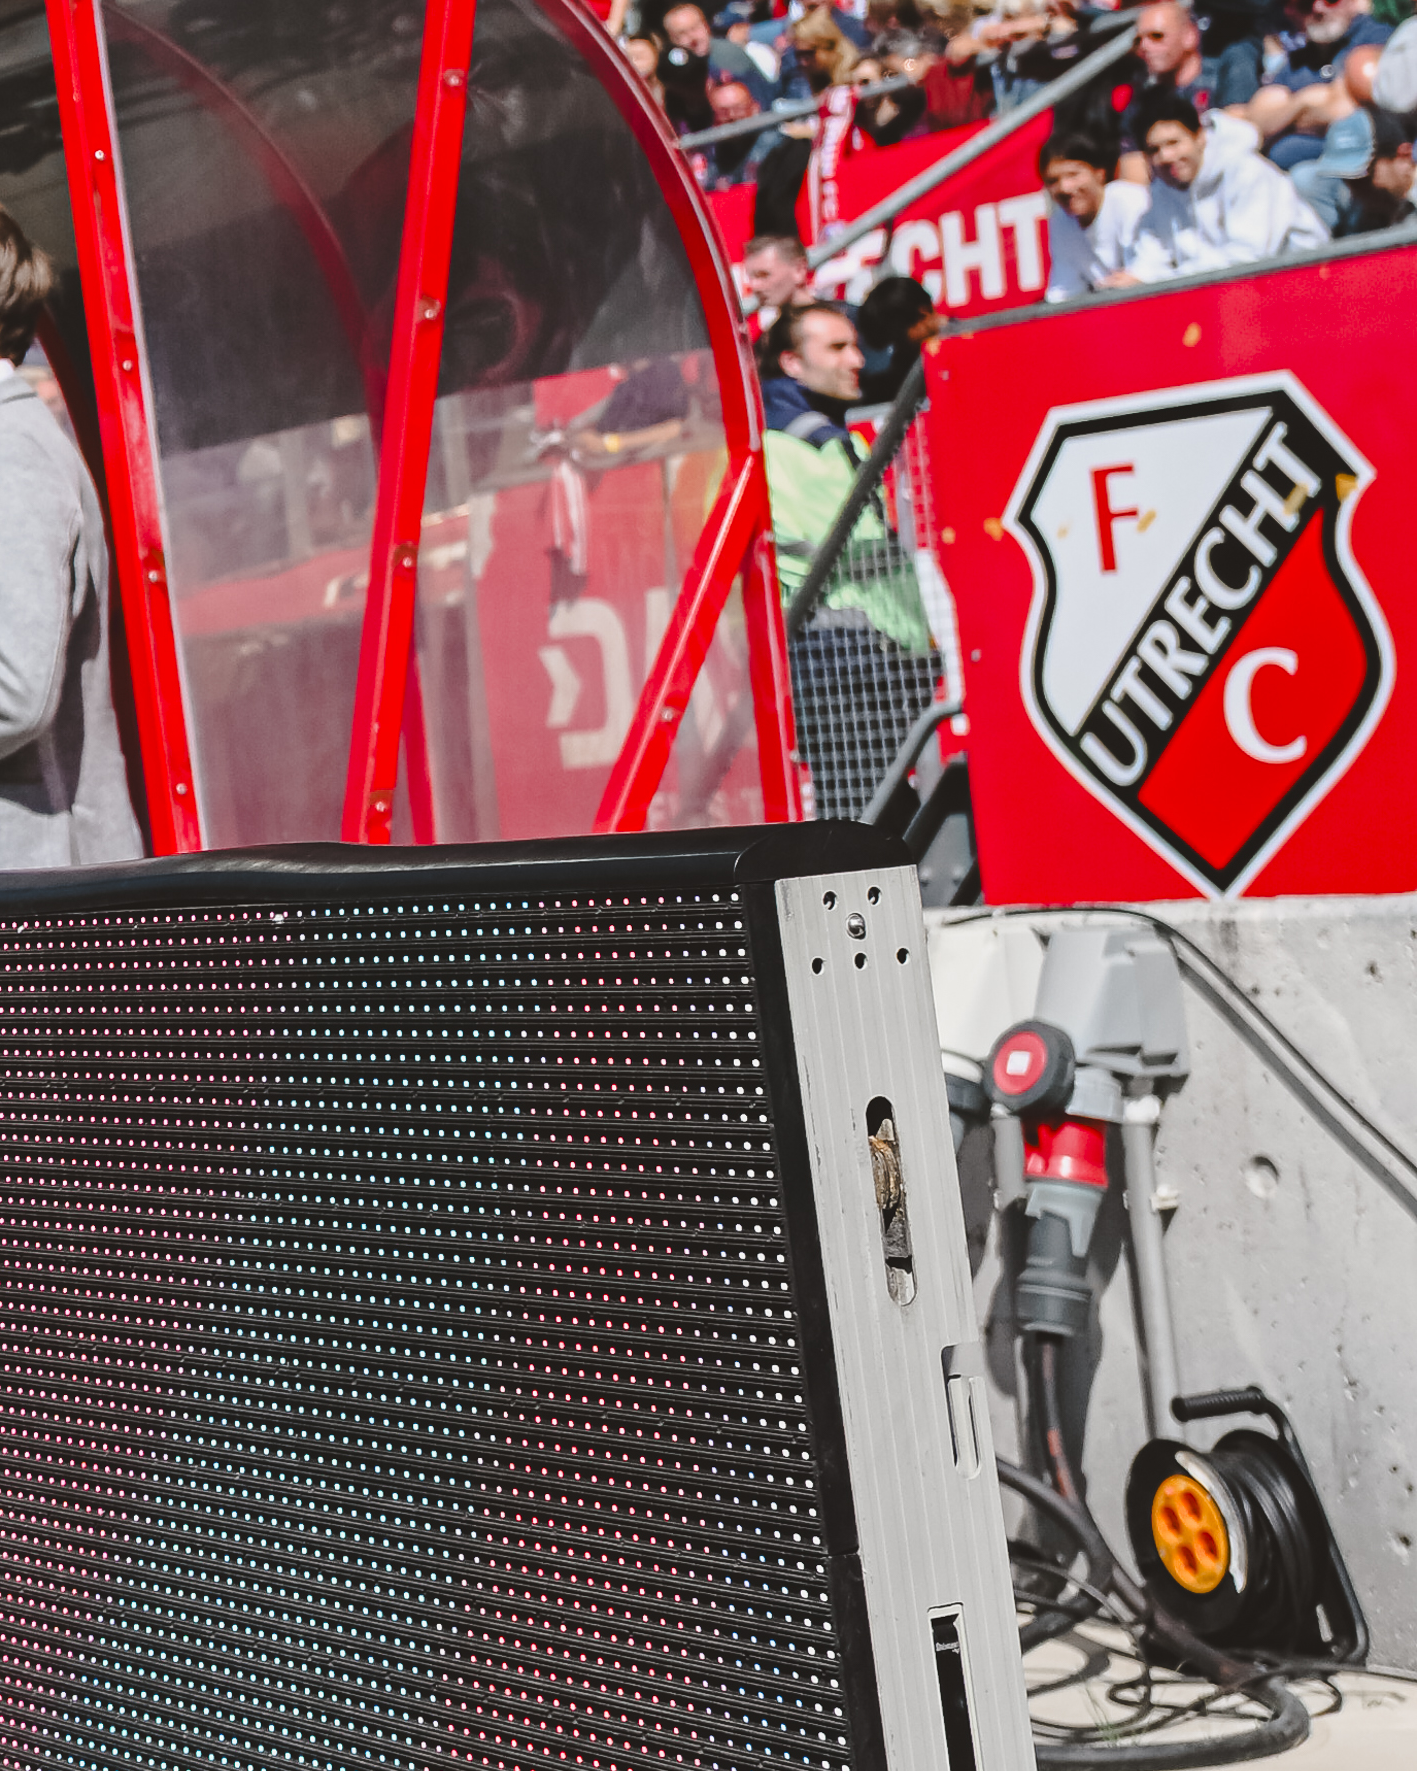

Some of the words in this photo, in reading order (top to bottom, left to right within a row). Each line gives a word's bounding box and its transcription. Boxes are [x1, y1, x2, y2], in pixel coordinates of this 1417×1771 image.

[1089, 459, 1139, 575] F
[1079, 421, 1322, 786] UTRECHT
[1222, 646, 1308, 765] C
